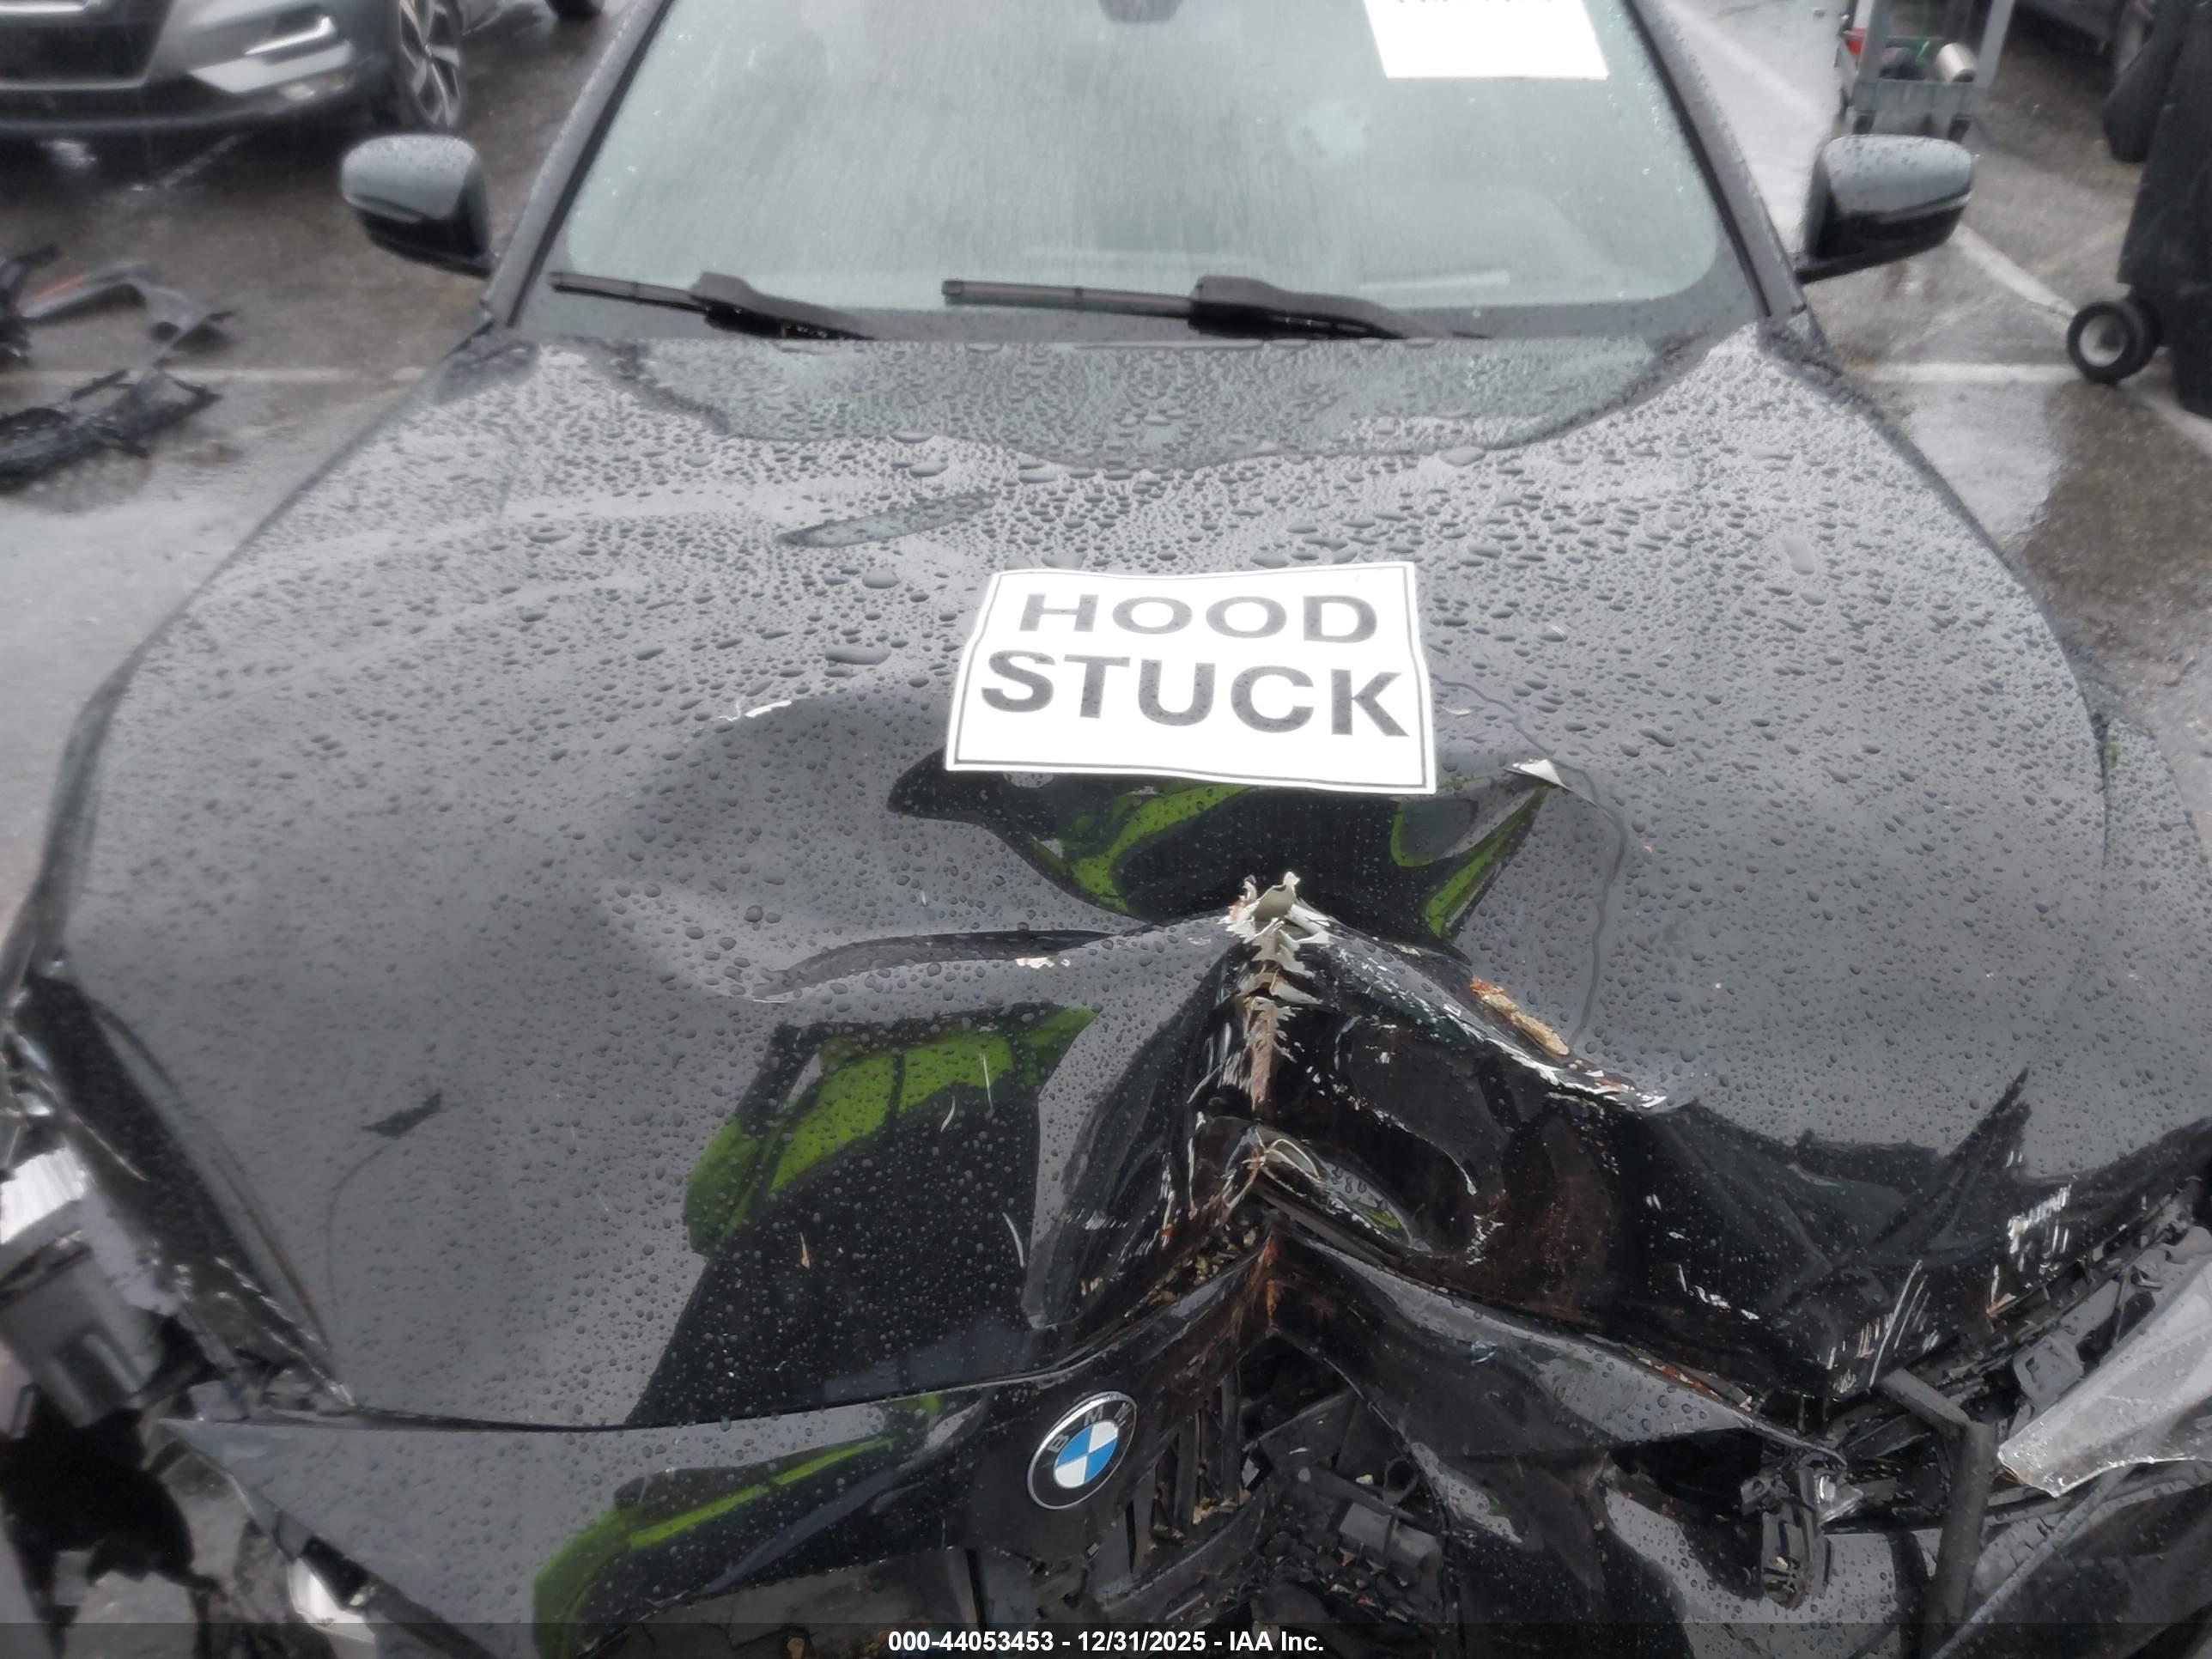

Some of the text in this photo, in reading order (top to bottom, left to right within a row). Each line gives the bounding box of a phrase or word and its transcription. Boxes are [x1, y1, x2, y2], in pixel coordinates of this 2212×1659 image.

[1018, 593, 1377, 643] HOOD
[981, 650, 1410, 737] STUCK
[1046, 1402, 1133, 1453] BMW
